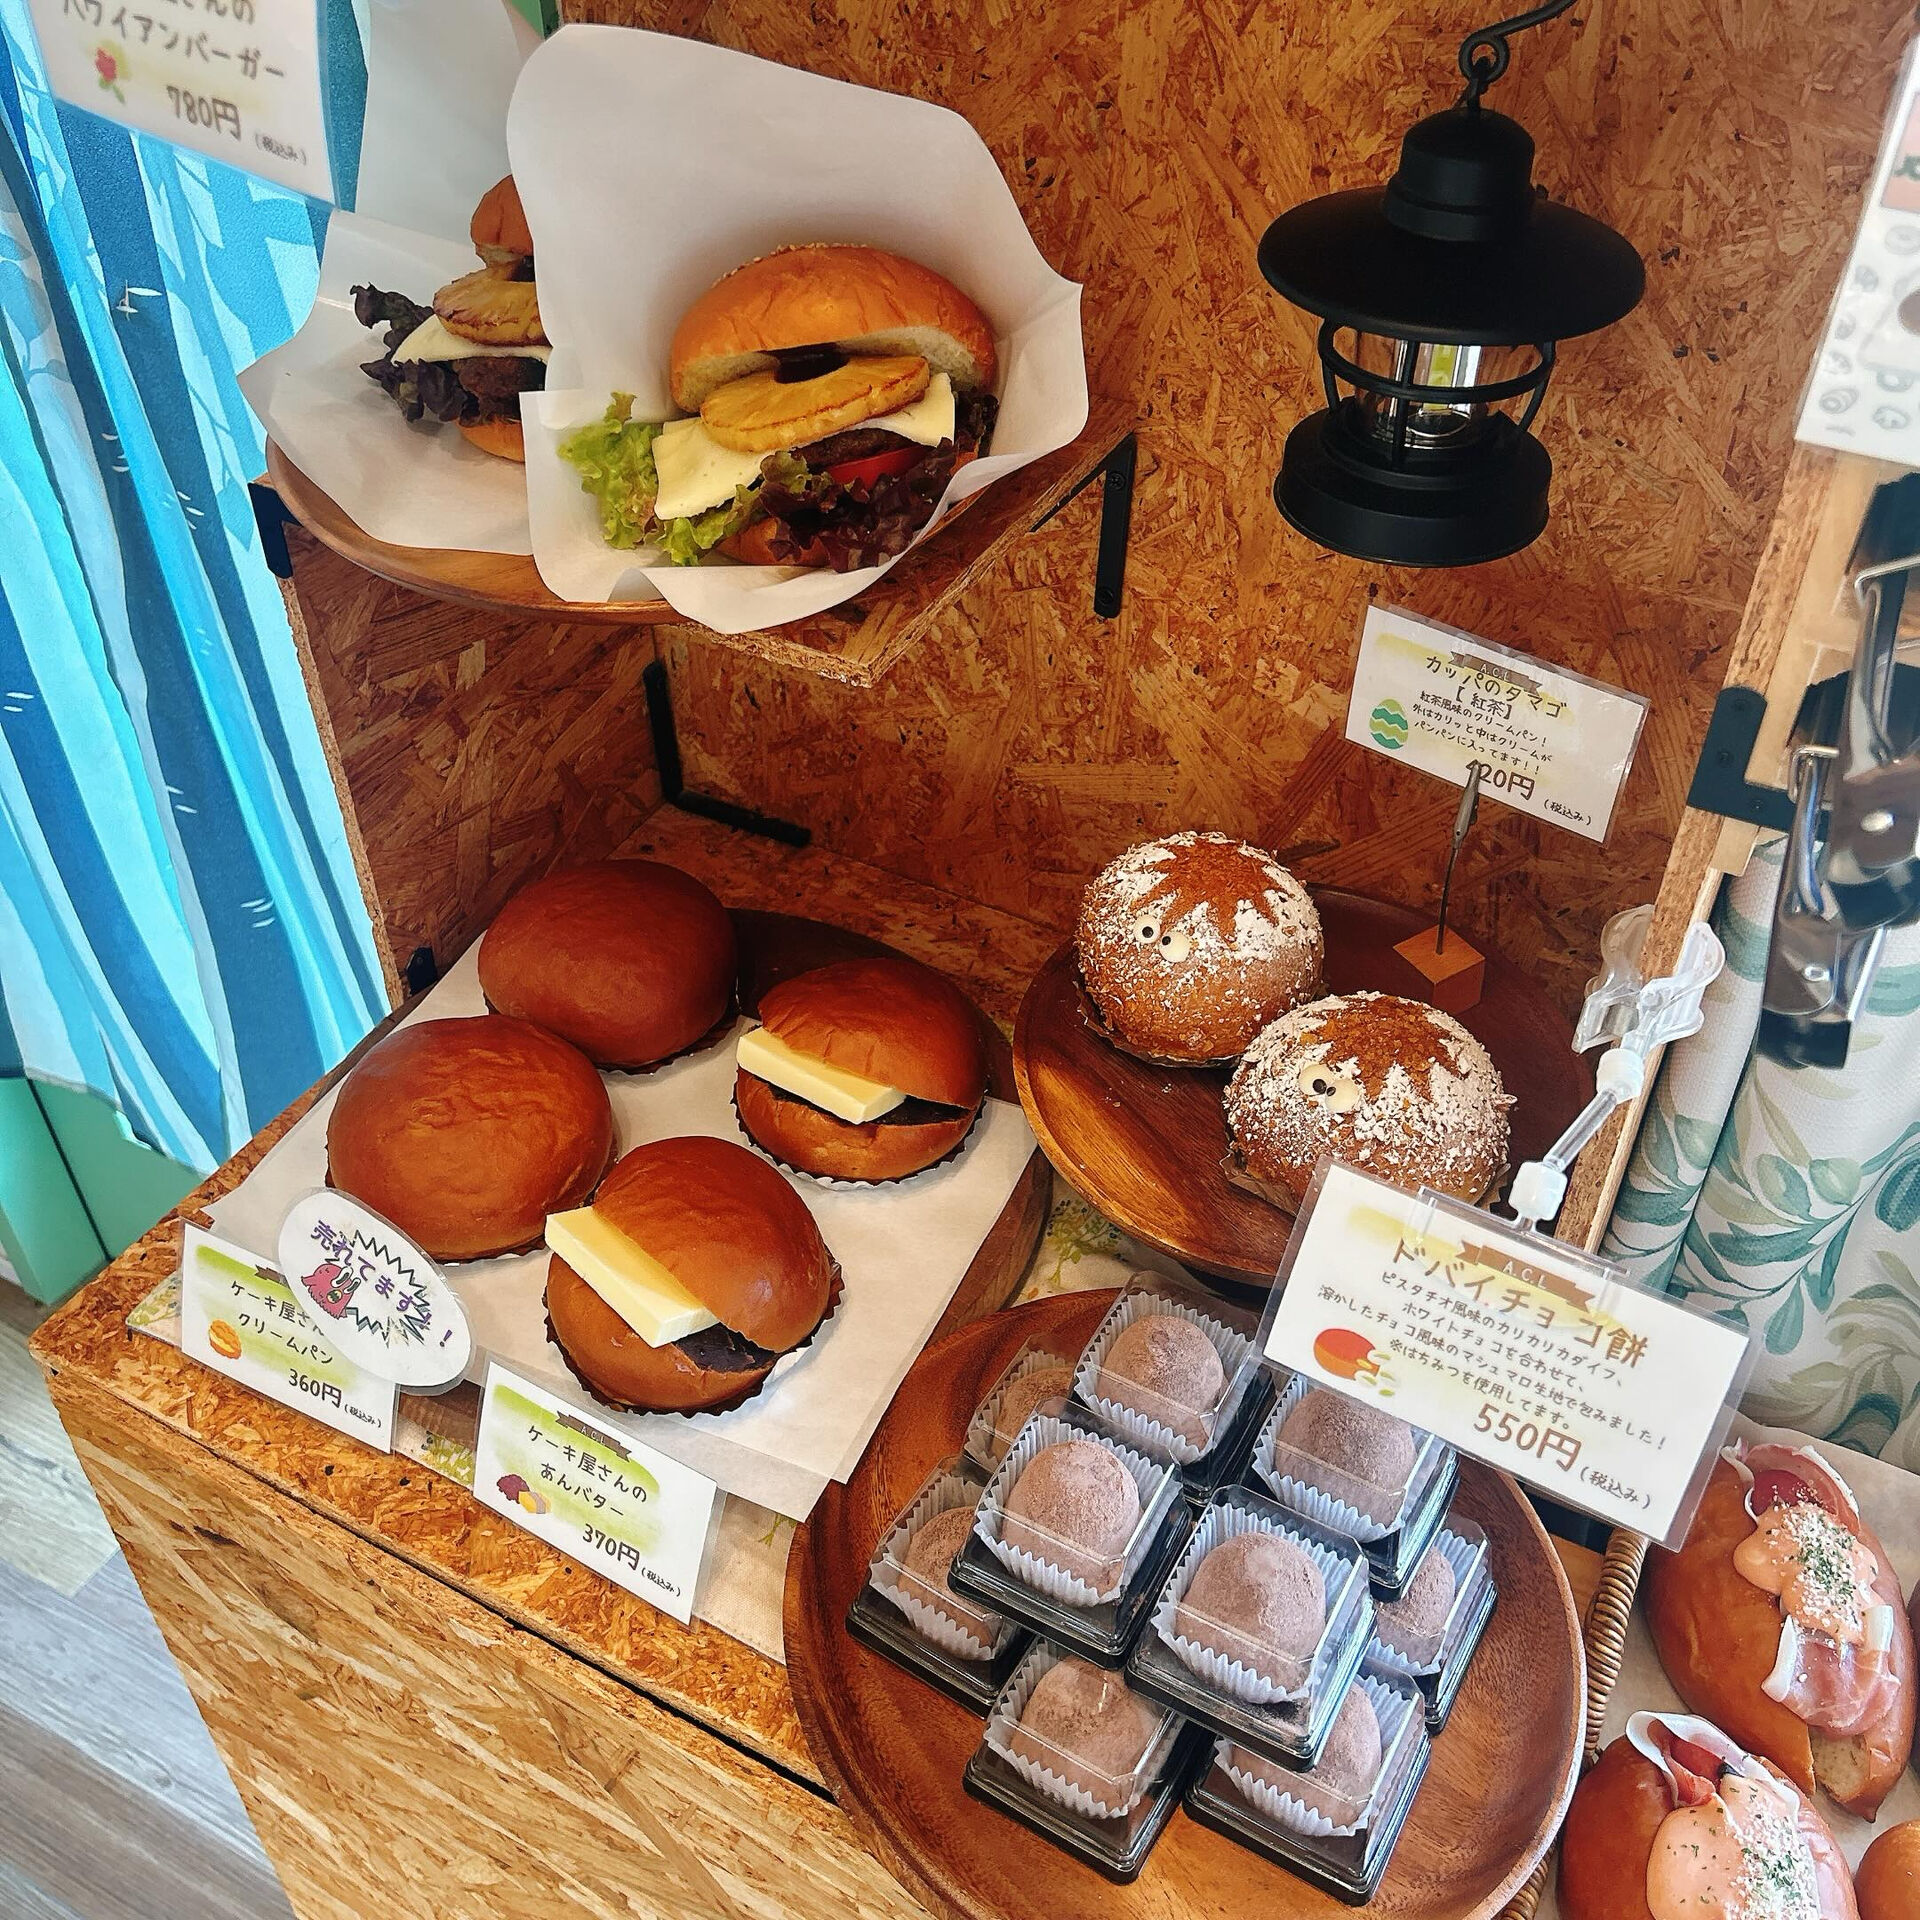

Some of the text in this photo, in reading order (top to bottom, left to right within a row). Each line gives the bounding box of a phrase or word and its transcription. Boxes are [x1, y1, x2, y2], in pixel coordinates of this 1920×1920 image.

[63, 0, 285, 80] ハワイアンバーガー
[166, 85, 241, 141] 780円
[1420, 691, 1547, 747] 紅茶風味のクリームパン!
[1426, 656, 1568, 719] カッパのタマゴ
[1456, 686, 1513, 719] 【紅茶】
[1413, 703, 1553, 762] 外はカリッと中はクリームが
[1415, 721, 1540, 775] パンパンに入ってます!!
[1544, 798, 1592, 826] (税込み)
[1382, 1271, 1622, 1388] ピスタチオ風味のカリカリカダイフ、
[1393, 1238, 1648, 1369] ドバイチョコ餅
[239, 1313, 333, 1364] クリームパン
[1318, 1285, 1666, 1450] 溶かしたチョコ風味のマシュマロ生地で包みました!
[1402, 1302, 1584, 1392] ホワイトチョコを合わせて、
[288, 1368, 382, 1428] 360円 (税込み)
[1389, 1339, 1570, 1430] ※はちみつを使用してます。
[528, 1425, 648, 1503] ケーキ屋さんの
[1473, 1405, 1652, 1509] 550円 (税込み)
[541, 1462, 624, 1517] あんバター
[582, 1523, 681, 1597] 370円 (税込み)
